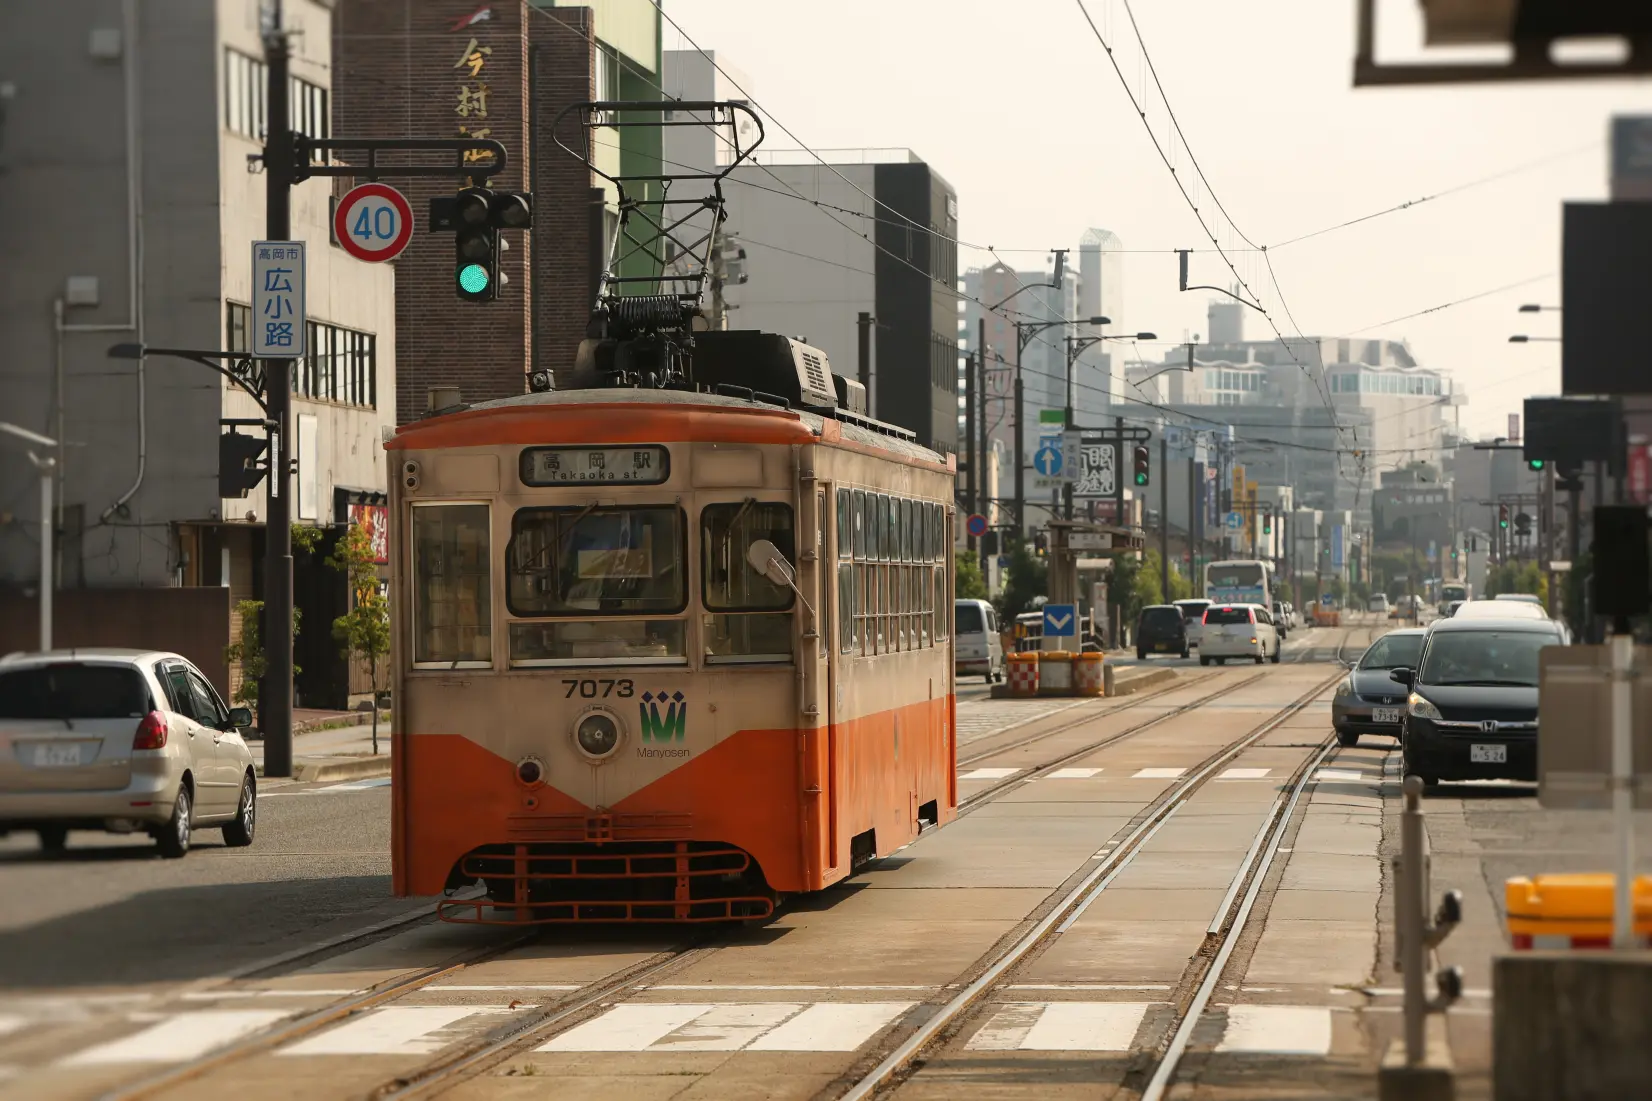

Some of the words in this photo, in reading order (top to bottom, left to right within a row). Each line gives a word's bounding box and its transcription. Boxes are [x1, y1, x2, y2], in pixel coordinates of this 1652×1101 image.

[353, 206, 395, 241] 40
[259, 248, 298, 260] 高岡市
[264, 267, 293, 347] 広小路
[542, 451, 652, 471] 高岡駅
[551, 470, 615, 480] Takaoka
[623, 470, 645, 479] st.
[561, 679, 634, 698] 7073
[637, 747, 690, 759] Manyosen
